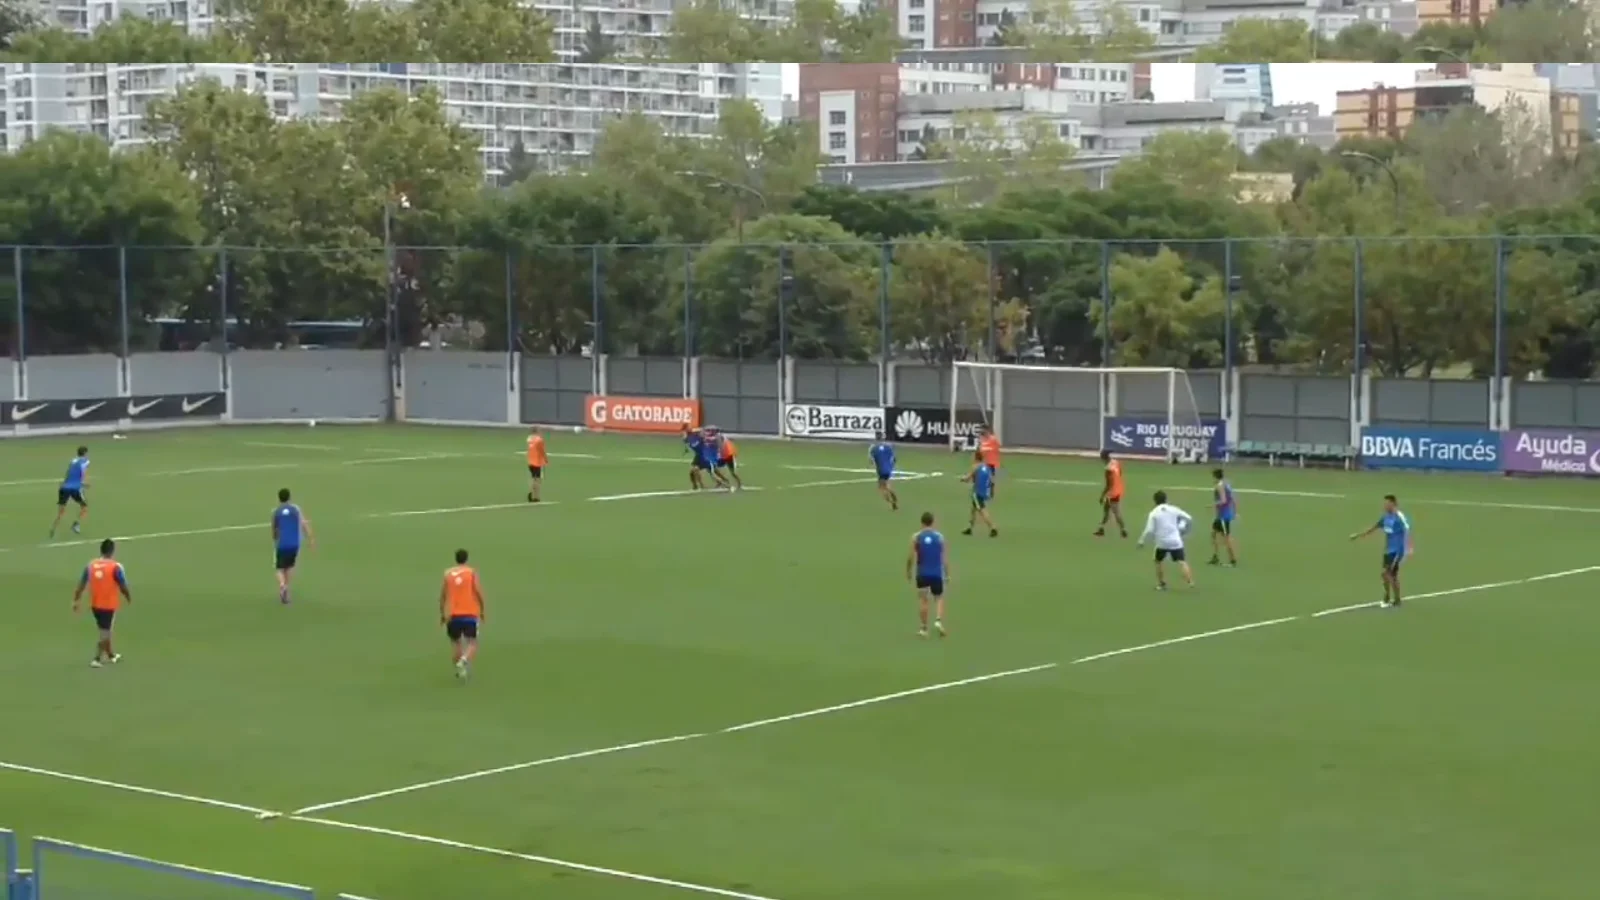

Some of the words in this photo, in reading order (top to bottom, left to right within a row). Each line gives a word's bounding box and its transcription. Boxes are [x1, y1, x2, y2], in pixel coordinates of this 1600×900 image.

[612, 404, 692, 423] GATORADE
[808, 406, 882, 430] Barraza
[927, 421, 984, 436] HUAWE
[1136, 423, 1157, 435] RIO
[1160, 424, 1217, 438] URUGUAY
[1362, 435, 1415, 458] BBVA
[1418, 437, 1496, 461] Francés
[1515, 432, 1586, 458] Ayuda
